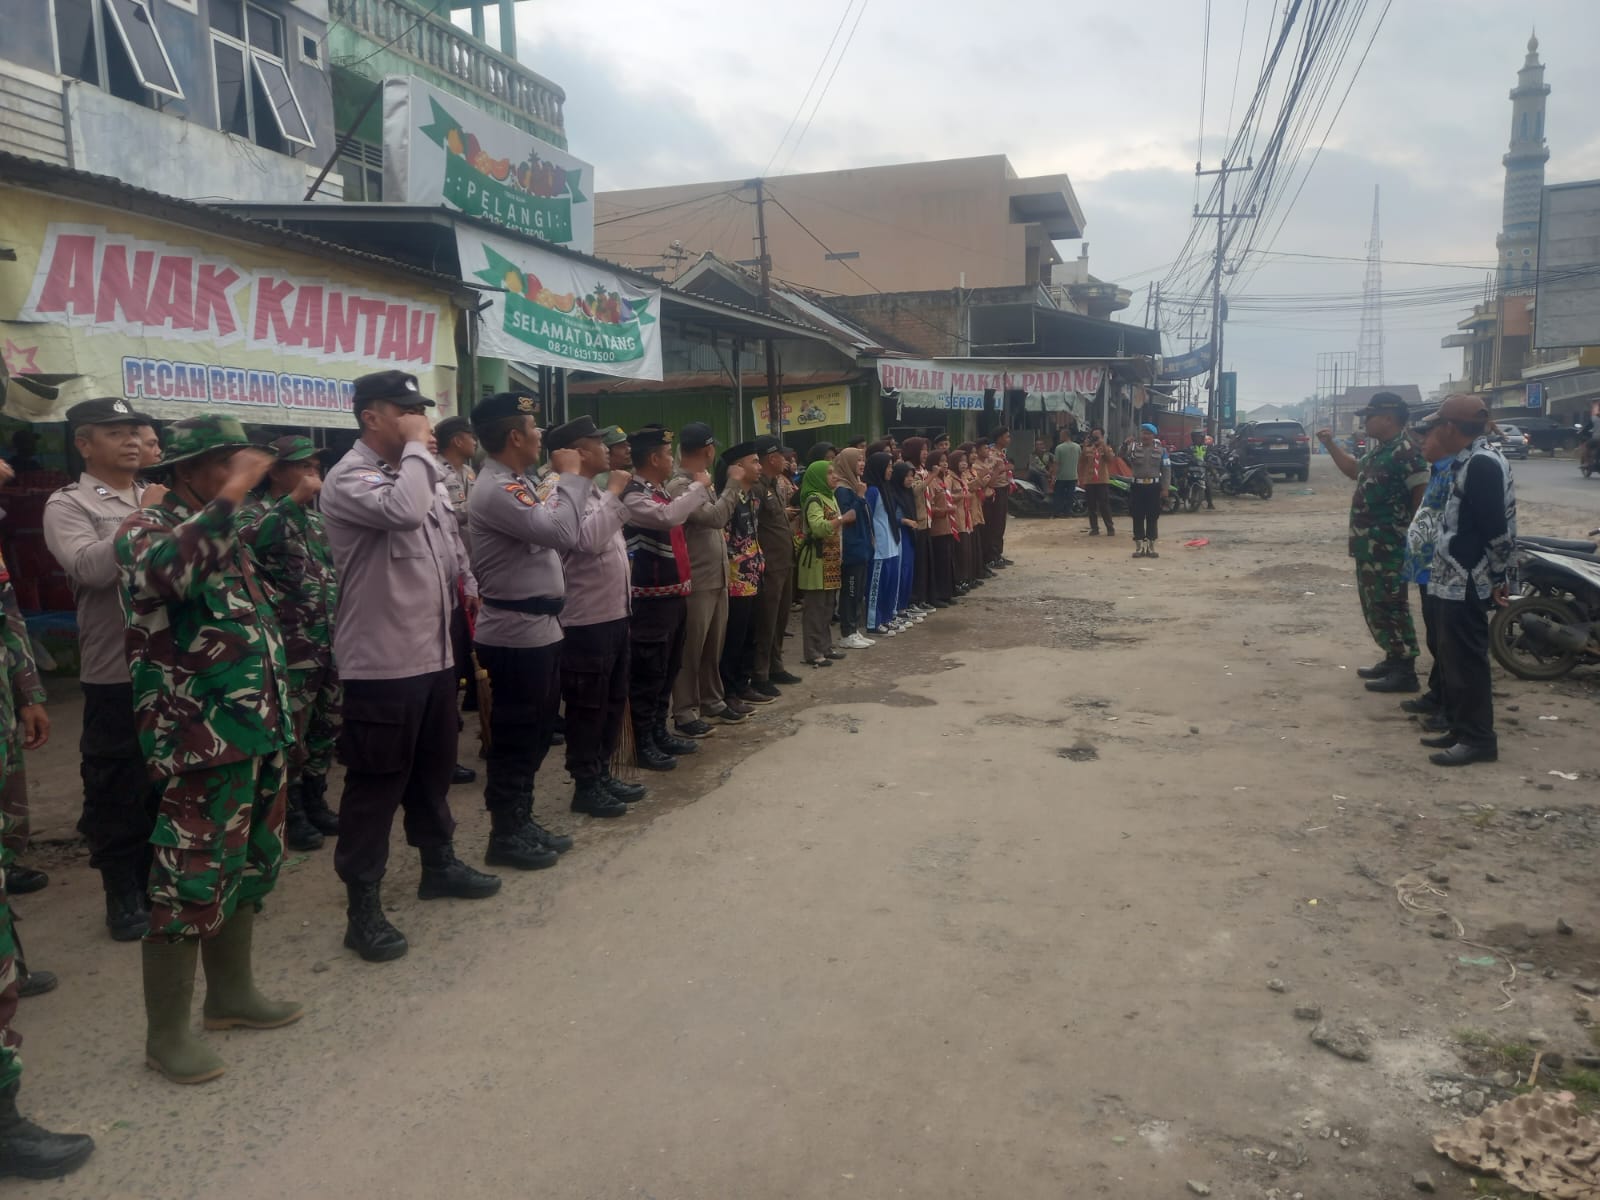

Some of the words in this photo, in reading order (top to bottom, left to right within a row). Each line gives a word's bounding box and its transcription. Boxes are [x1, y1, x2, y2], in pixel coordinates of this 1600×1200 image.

[467, 181, 552, 228] PELANGI
[36, 233, 241, 337] ANAK
[253, 277, 436, 365] KANTAU
[512, 311, 582, 345] SELAMAT
[584, 331, 636, 351] DATANG
[547, 340, 573, 356] 0821
[592, 351, 615, 361] 7500
[124, 359, 207, 399] PECAH
[209, 367, 277, 405] BELAH
[279, 374, 339, 410] SERBA
[881, 364, 945, 390] RUMAH
[951, 371, 1014, 392] MAKAN
[1022, 367, 1099, 393] PADANG
